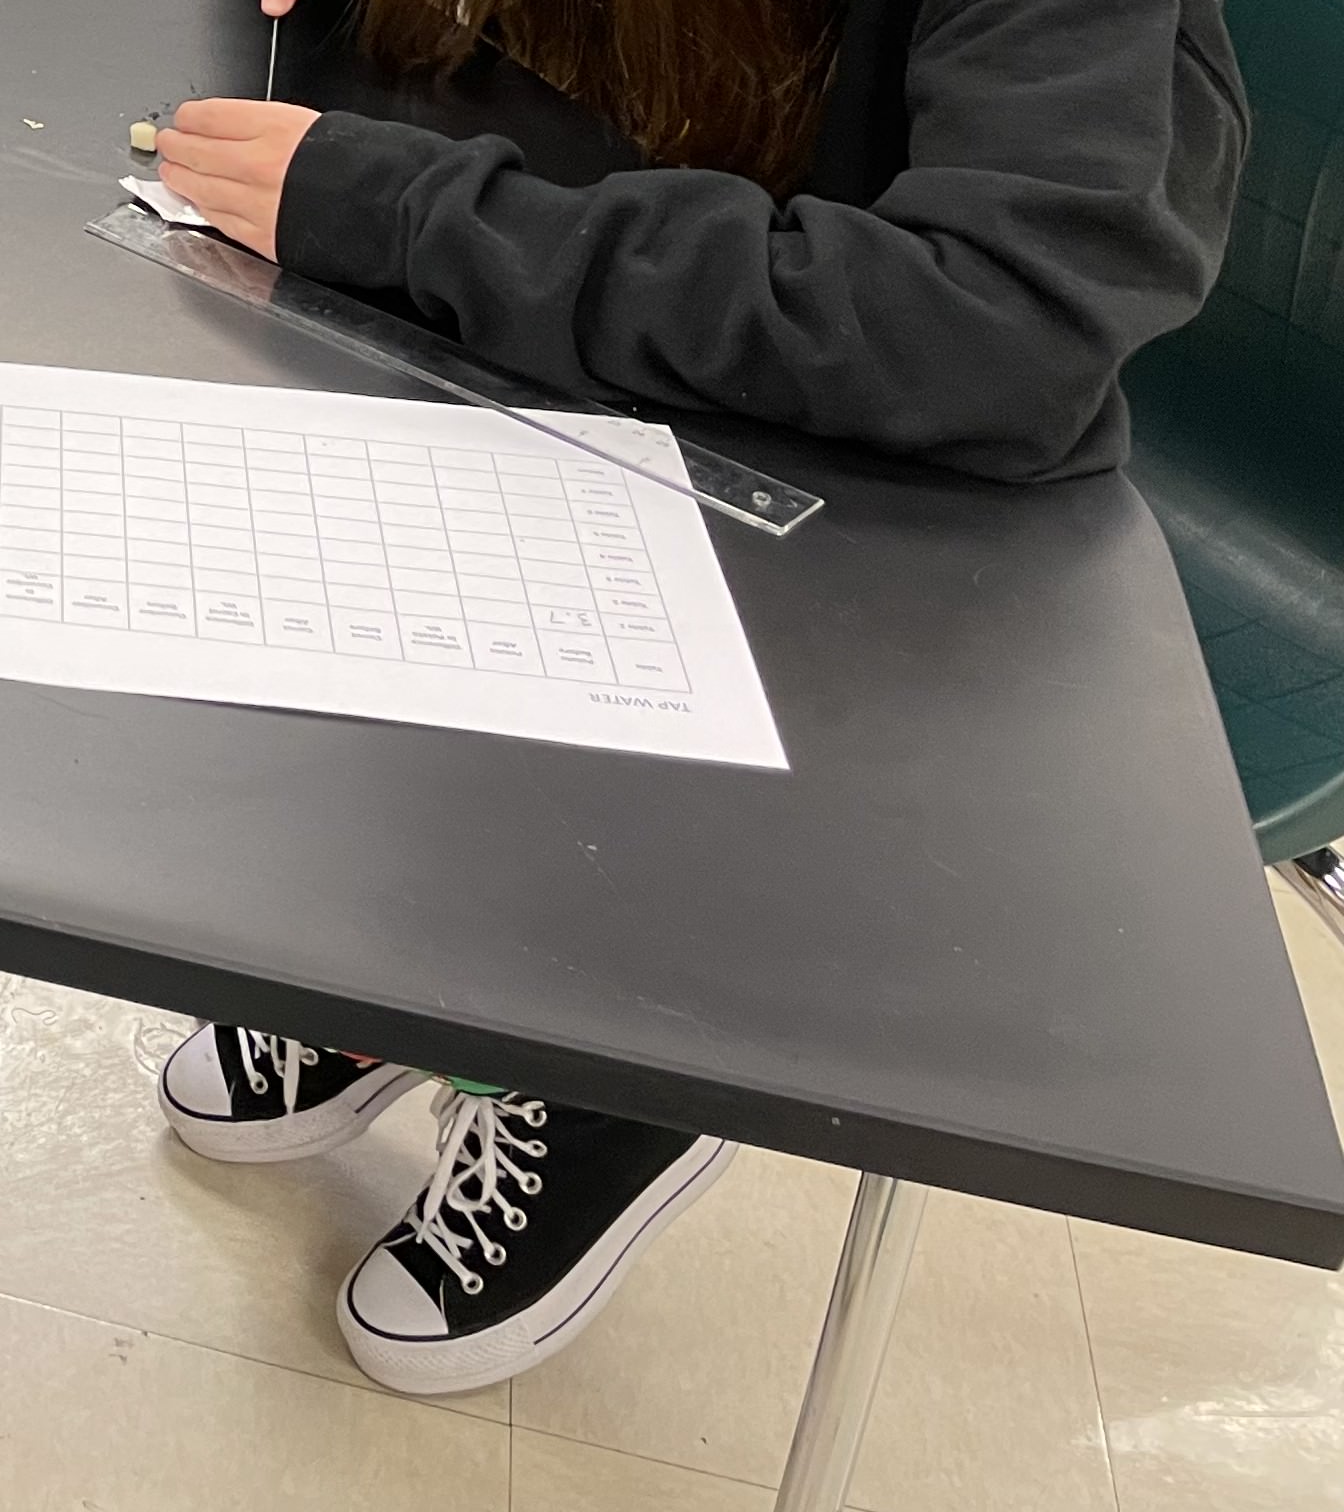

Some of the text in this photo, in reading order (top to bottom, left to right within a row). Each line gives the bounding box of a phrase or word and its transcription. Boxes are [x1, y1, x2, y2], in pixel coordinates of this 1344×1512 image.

[549, 610, 592, 627] 3.7
[588, 693, 691, 712] TAP WATER
